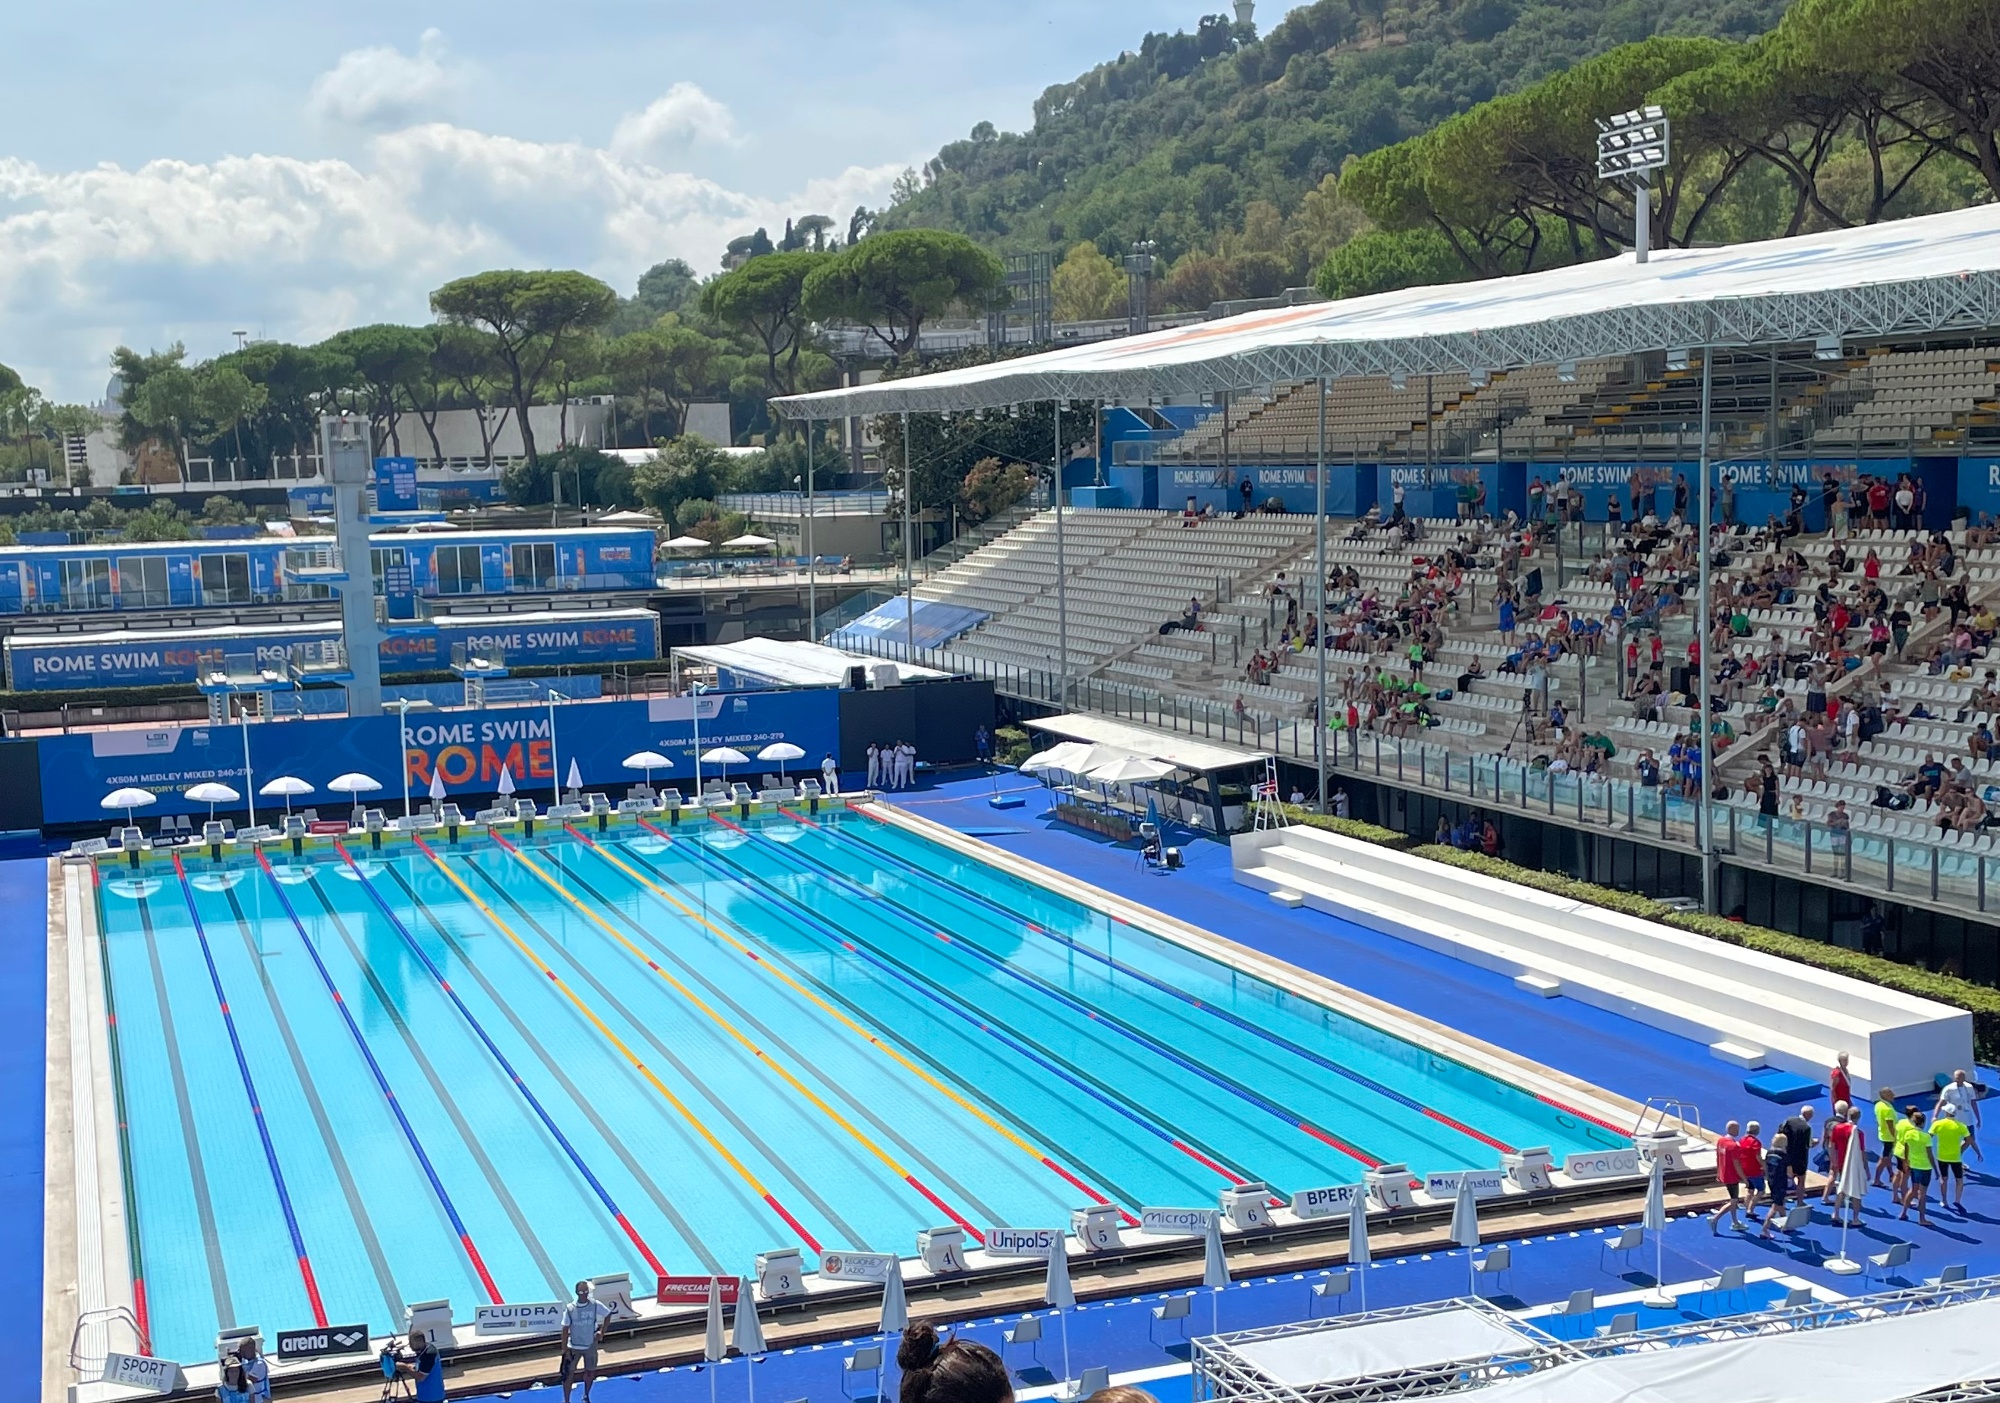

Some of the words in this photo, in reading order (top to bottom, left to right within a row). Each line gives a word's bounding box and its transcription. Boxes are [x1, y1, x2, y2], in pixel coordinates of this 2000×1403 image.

[1174, 470, 1194, 484] ROME
[1195, 470, 1215, 484] SWIM
[1259, 469, 1282, 484] ROME
[1283, 469, 1305, 484] SWIM
[1306, 469, 1331, 484] ROE
[1391, 468, 1420, 484] ROME
[1596, 466, 1632, 483] SWIM
[1718, 464, 1762, 484] ROME
[380, 638, 437, 655] ROME
[467, 633, 522, 651] ROME
[526, 631, 579, 648] SWIM
[583, 628, 636, 646] ROME
[33, 654, 96, 674] ROME
[101, 651, 159, 671] SWIM
[164, 648, 225, 666] ROME
[402, 723, 475, 746] ROME
[481, 719, 550, 742] SWIM
[659, 739, 687, 747] 4X50M
[688, 736, 723, 745] MEDLEY
[725, 734, 752, 743] MIXED
[405, 740, 555, 787] ROME
[105, 775, 139, 785] 4X50M
[140, 773, 182, 783] MEDLEY
[184, 770, 215, 780] MIXED
[1573, 1158, 1611, 1174] enel
[1664, 1153, 1674, 1165] 9
[1444, 1178, 1501, 1190] Mamsten
[1530, 1171, 1540, 1184] 8
[1391, 1190, 1400, 1202] 7
[1143, 1211, 1206, 1230] Microplu
[1248, 1208, 1257, 1222] 6
[992, 1230, 1054, 1253] UnipolSa
[1098, 1230, 1108, 1243] 5
[844, 1256, 876, 1266] REGIONE
[942, 1252, 951, 1265] 4
[844, 1266, 866, 1275] LAZIO
[664, 1284, 735, 1293] FRECCIARSSA
[780, 1275, 790, 1289] 3
[478, 1306, 559, 1320] FLUIDRA
[608, 1301, 619, 1315] 2
[281, 1333, 329, 1352] arena
[427, 1328, 436, 1343] 1
[122, 1357, 168, 1377] SPORT
[119, 1372, 126, 1380] E
[127, 1374, 164, 1388] SALUTE
